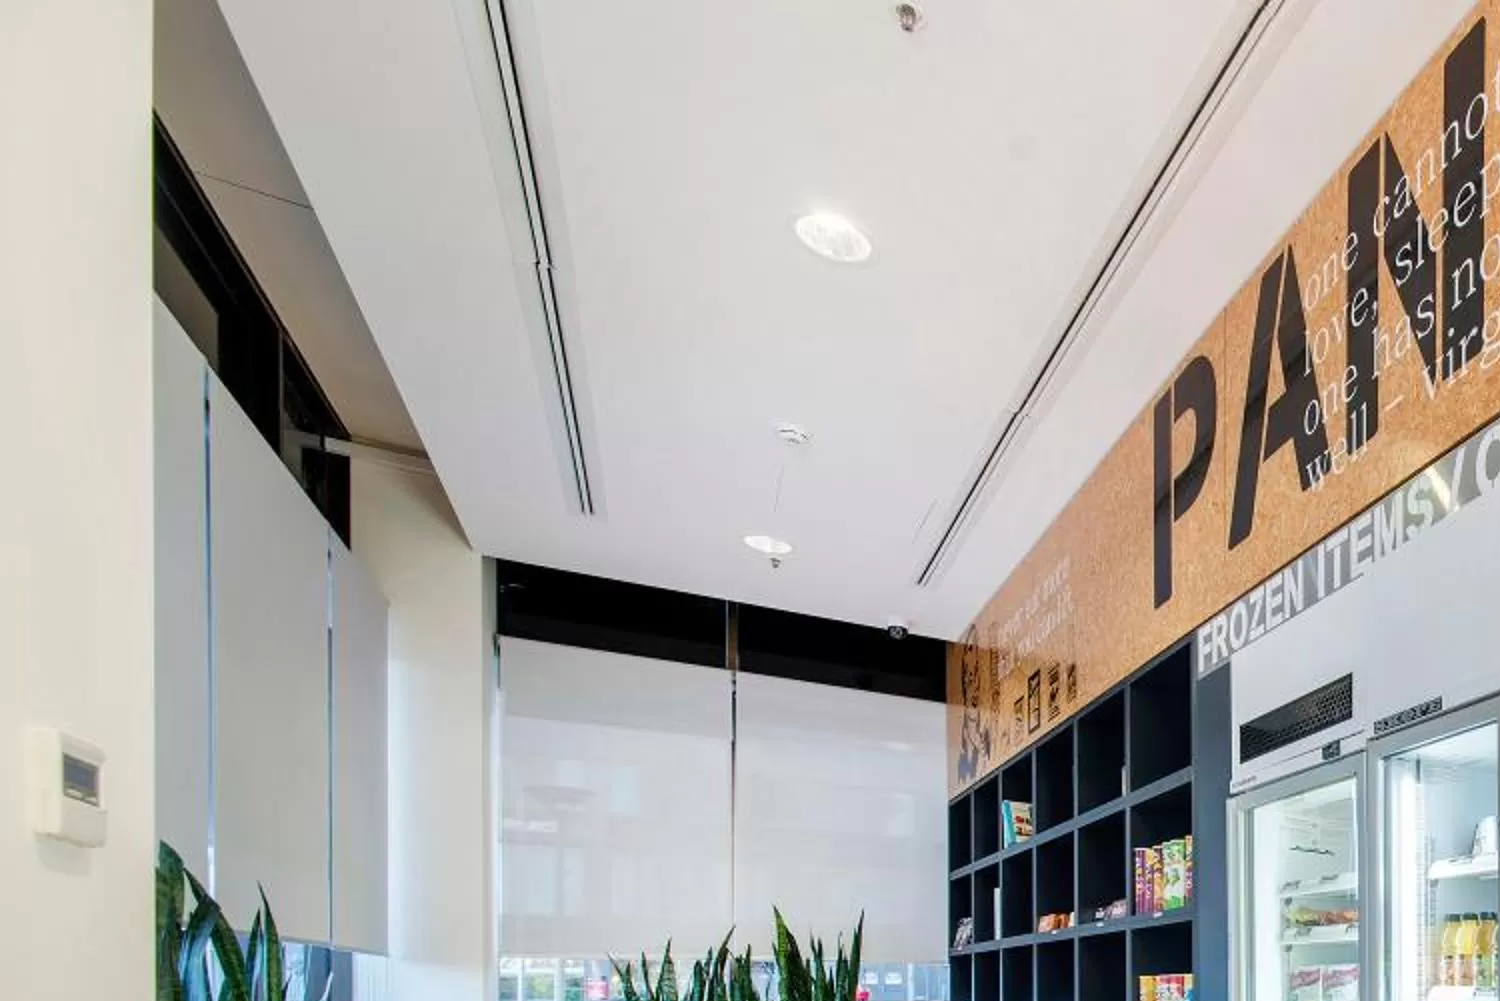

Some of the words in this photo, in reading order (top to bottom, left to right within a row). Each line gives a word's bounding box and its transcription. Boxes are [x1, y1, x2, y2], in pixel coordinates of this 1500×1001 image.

[1304, 231, 1359, 312] one
[1304, 286, 1378, 377] love,
[1304, 363, 1359, 436] one
[1372, 292, 1436, 380] has
[1304, 402, 1369, 493] well
[1197, 560, 1303, 675] FROZEN
[1316, 472, 1433, 600] ITEMS
